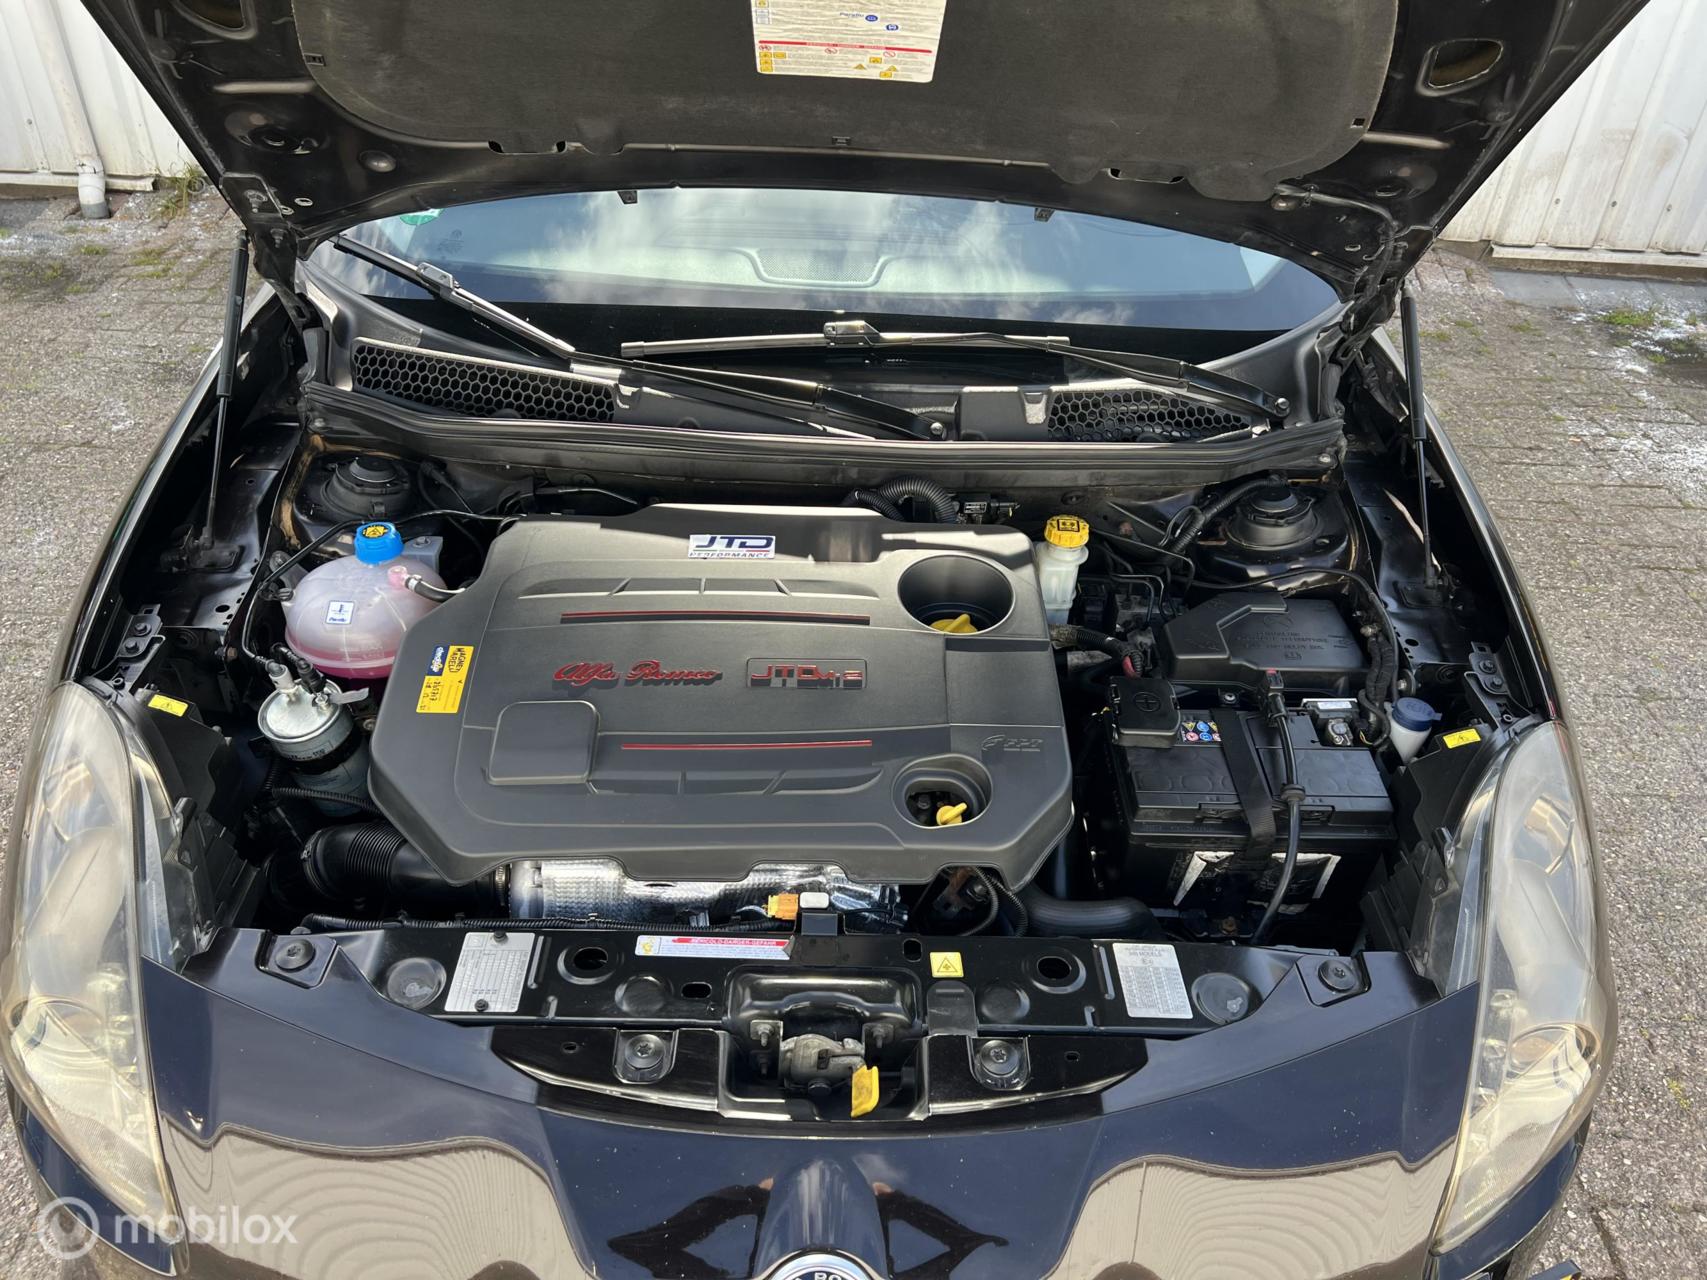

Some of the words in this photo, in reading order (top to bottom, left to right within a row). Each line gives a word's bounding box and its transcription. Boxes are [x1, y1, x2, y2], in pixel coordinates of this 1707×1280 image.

[695, 535, 774, 549] JTD
[553, 661, 618, 688] Alfa
[625, 660, 723, 684] Romeo
